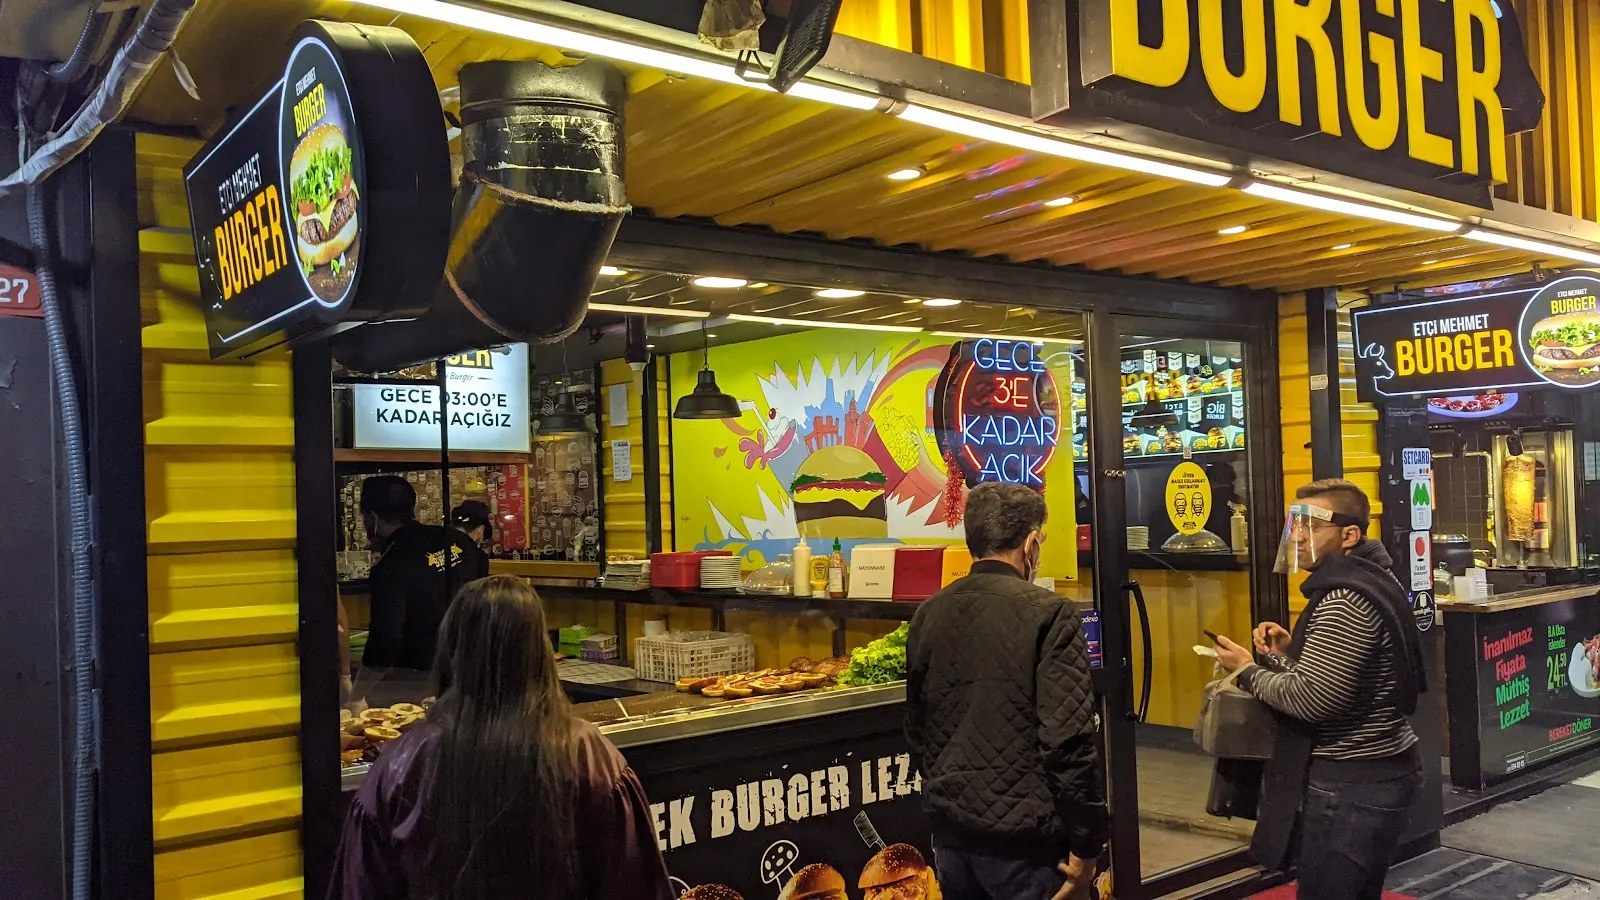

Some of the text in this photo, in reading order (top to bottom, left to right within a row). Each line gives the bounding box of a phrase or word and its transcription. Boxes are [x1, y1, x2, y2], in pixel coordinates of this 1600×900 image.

[293, 82, 328, 138] BURGER
[214, 184, 289, 300] BURGER
[0, 277, 29, 304] 27
[1550, 295, 1597, 315] BURGER
[1567, 287, 1588, 297] MEHMET
[1440, 313, 1490, 334] MEHMET
[974, 338, 1046, 372] GECE
[1395, 328, 1516, 377] BURGER
[449, 371, 474, 383] Burger
[380, 388, 432, 404] GECE
[376, 408, 512, 428] KADAR AÇIĞIZ
[961, 414, 1058, 446] KADAR
[1403, 450, 1430, 465] SETCARD
[1483, 627, 1533, 661] İnanılmaz
[1495, 654, 1526, 682] Fiyata
[1495, 674, 1531, 707] Müthiş
[1499, 698, 1530, 730] Lezzet
[709, 764, 851, 839] BURGER
[861, 752, 923, 805] LEZ
